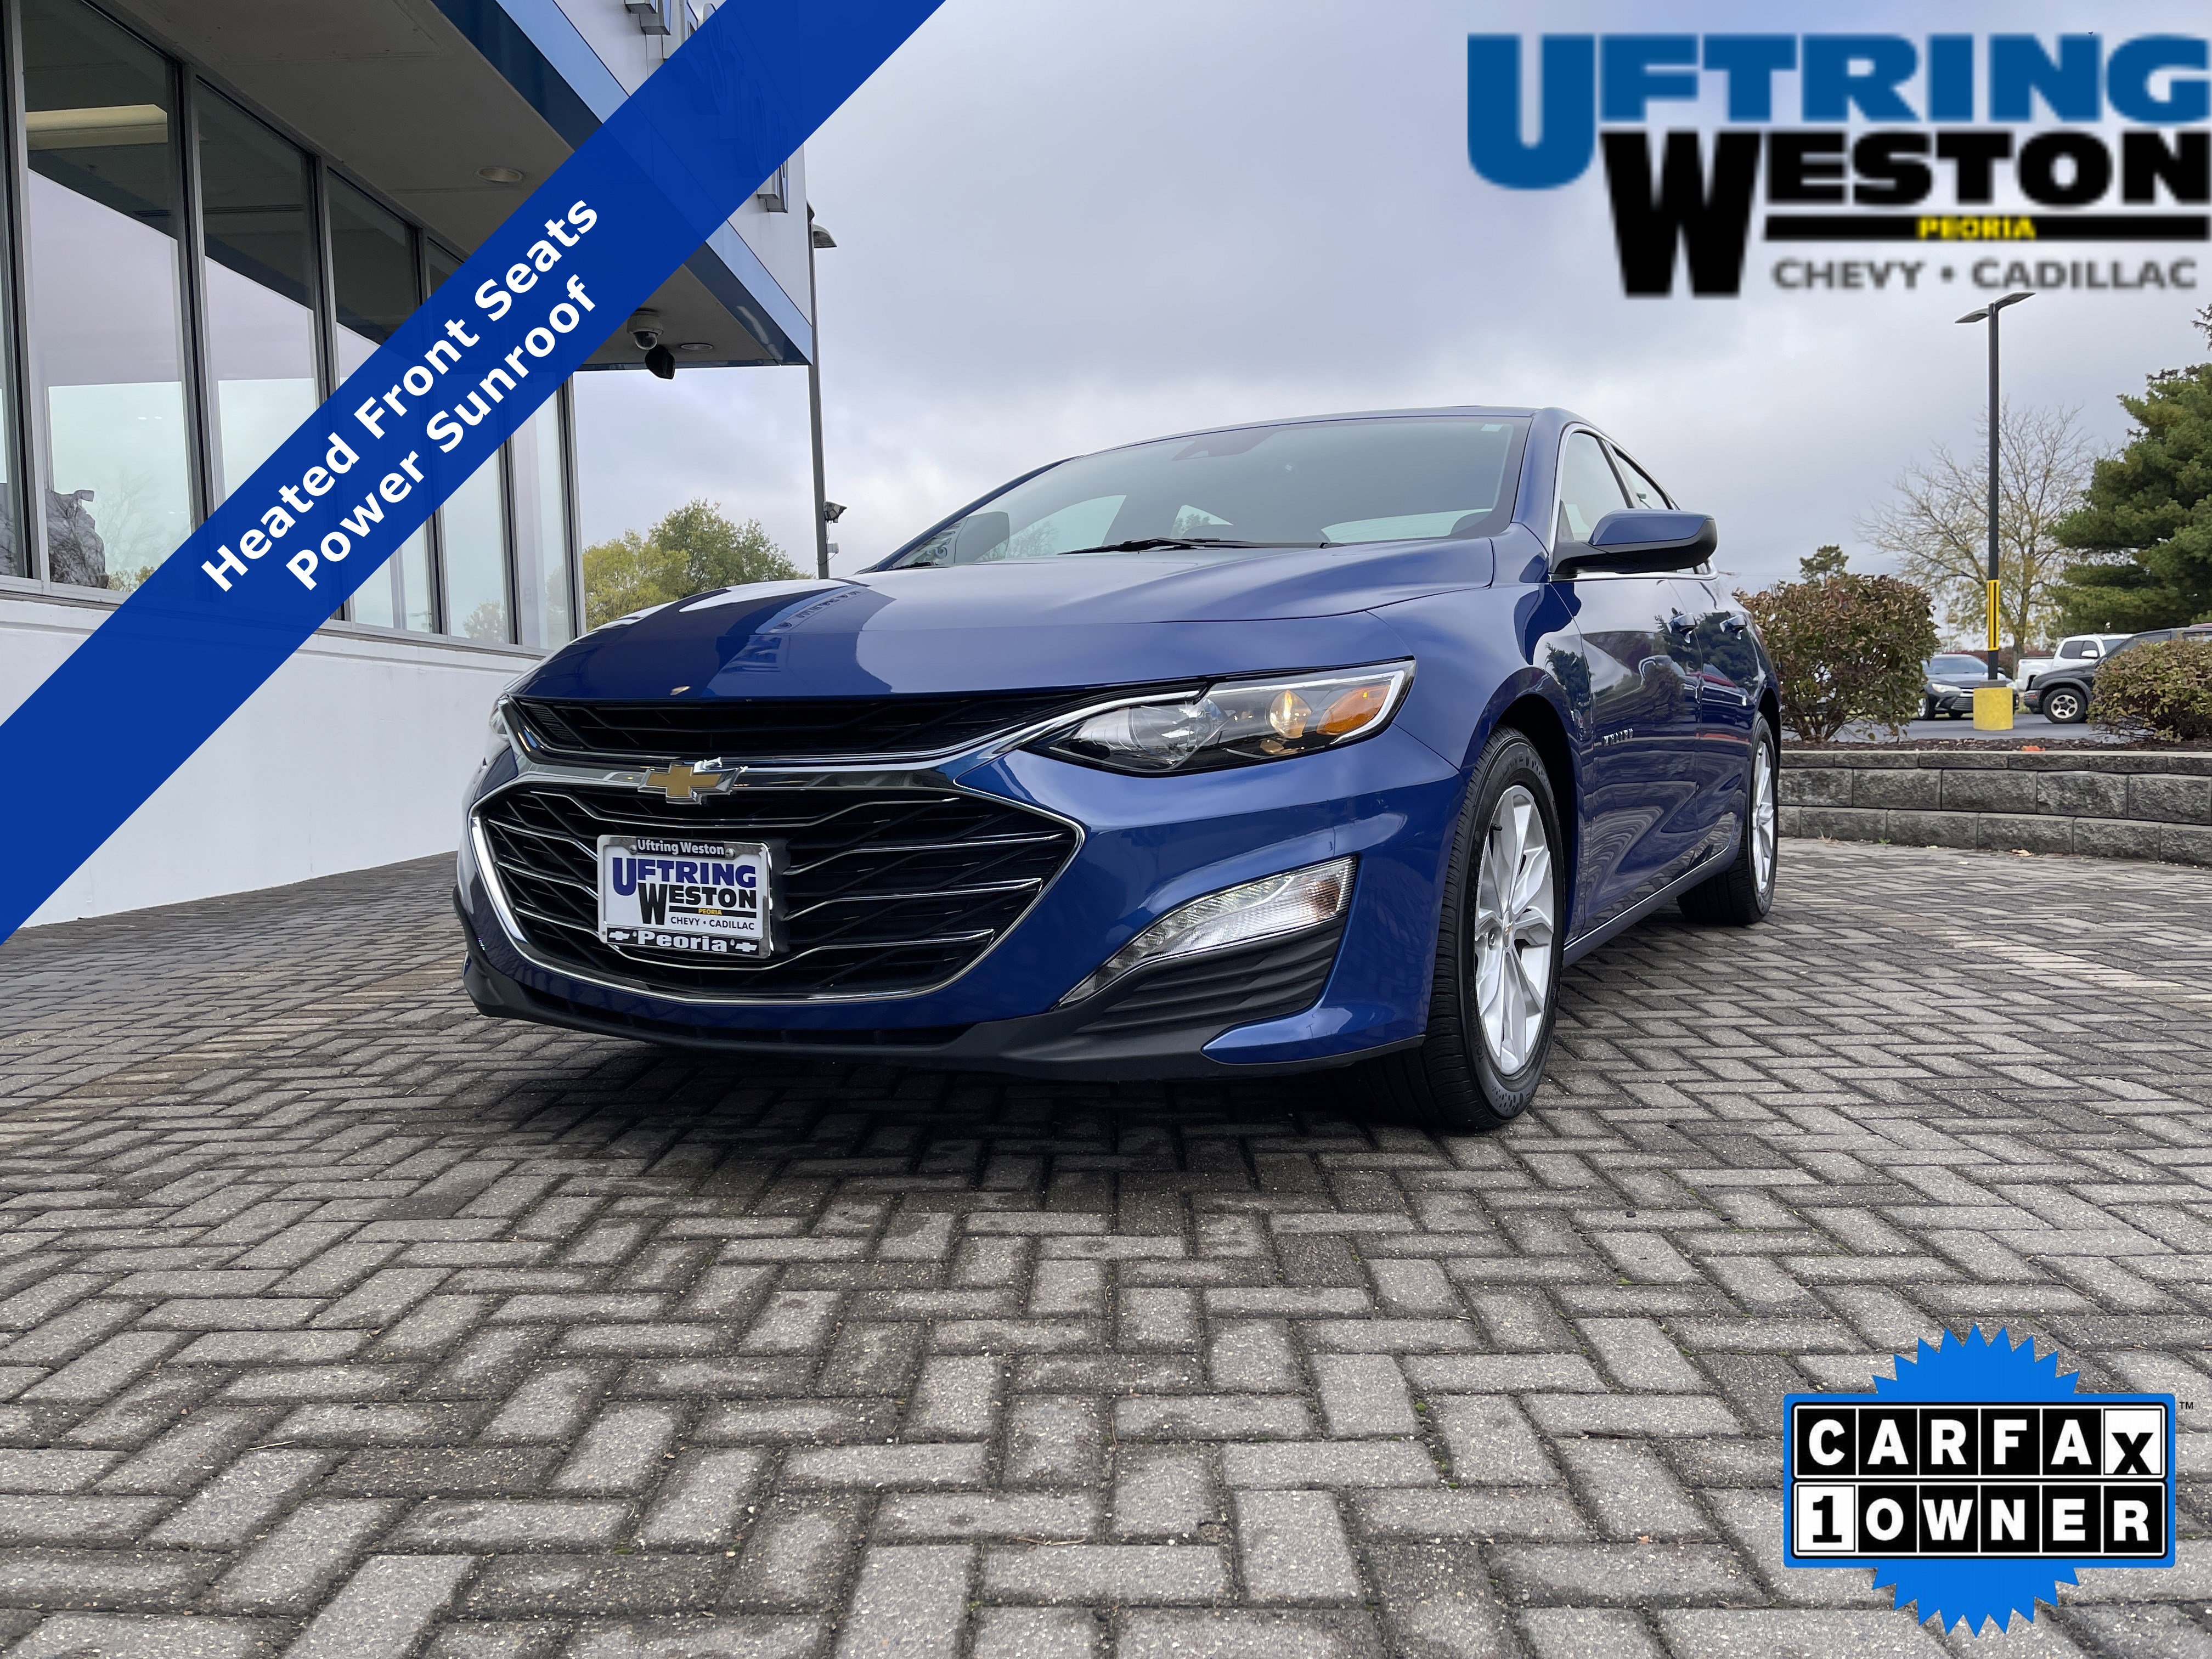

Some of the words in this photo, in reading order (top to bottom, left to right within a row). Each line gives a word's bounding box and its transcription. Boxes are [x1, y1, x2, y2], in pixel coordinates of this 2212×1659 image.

[637, 839, 679, 855] Uftring
[680, 842, 724, 855] Weston
[612, 857, 757, 896] UFTRING
[638, 882, 757, 925] WESTON
[670, 916, 700, 926] CHEVY
[709, 919, 754, 930] CADILLAC
[637, 930, 727, 952] Peoria
